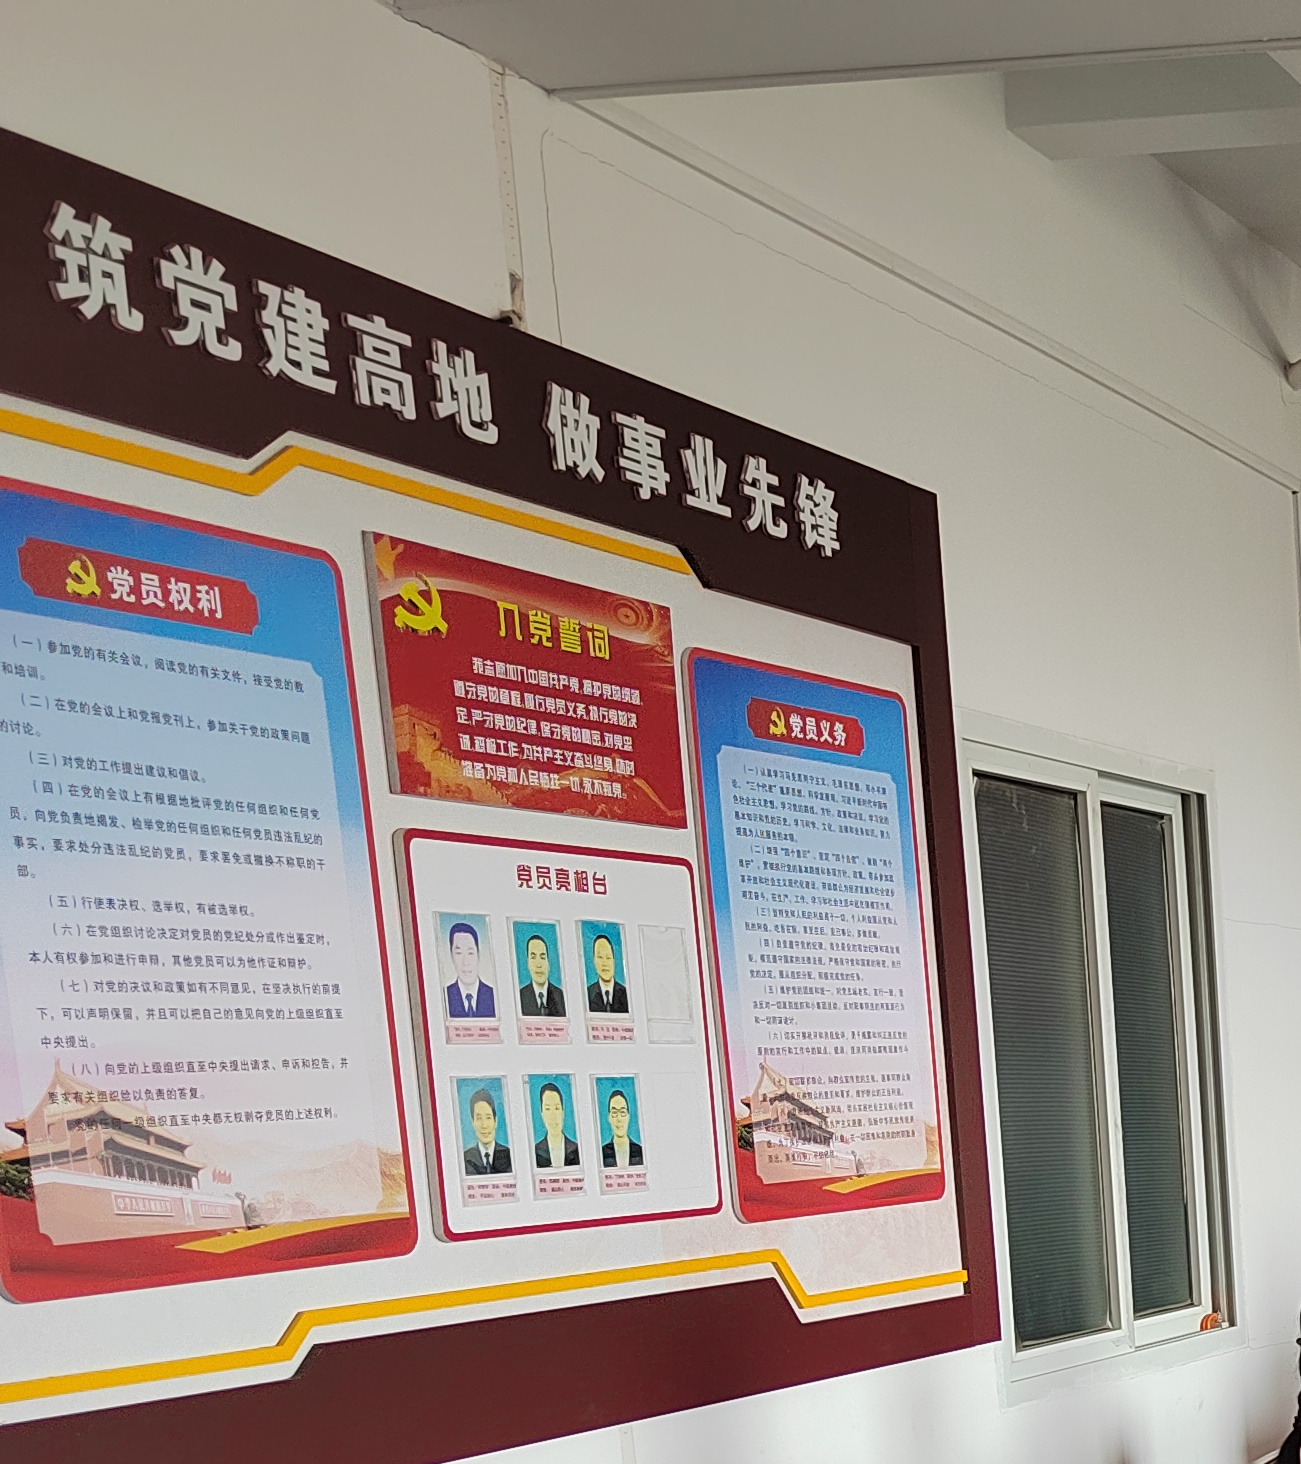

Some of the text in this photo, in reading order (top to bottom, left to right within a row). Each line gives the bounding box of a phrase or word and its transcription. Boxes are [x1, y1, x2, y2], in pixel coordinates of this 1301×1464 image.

[48, 200, 842, 558] 筑党建高地 做事业先锋
[106, 563, 223, 620] 党员权利
[497, 601, 610, 660] 入党誓词
[789, 713, 847, 747] 党员义务
[517, 863, 608, 896] 党员亮相台
